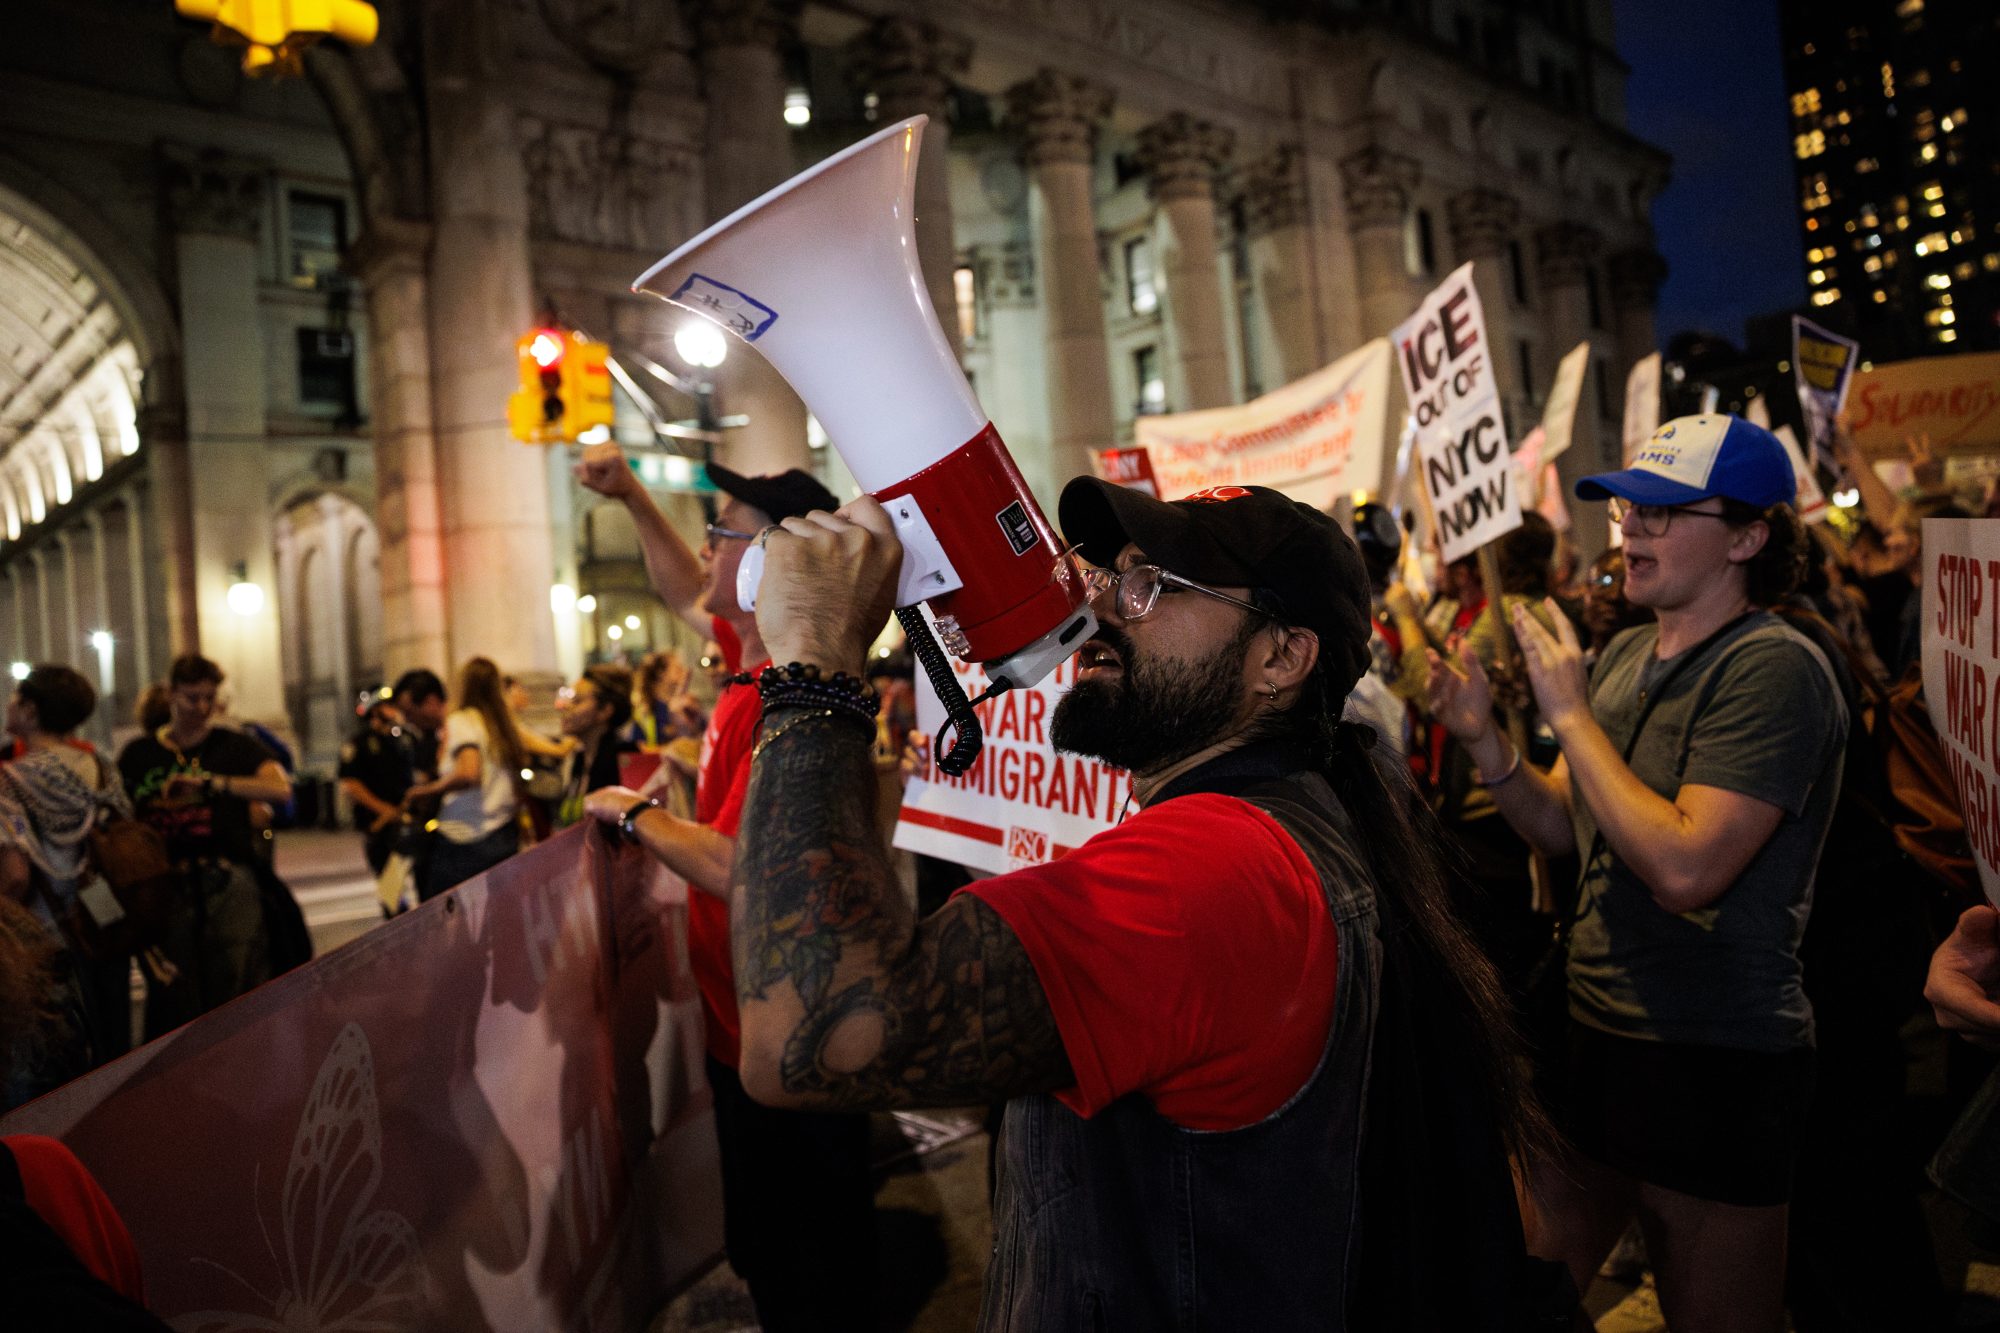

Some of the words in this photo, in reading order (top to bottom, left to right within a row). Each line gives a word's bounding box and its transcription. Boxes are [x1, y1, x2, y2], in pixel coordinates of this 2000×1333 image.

[1402, 287, 1478, 392] ICE
[1453, 354, 1482, 398] OF
[1428, 416, 1500, 498] NYC
[1439, 470, 1506, 544] NOW
[1938, 553, 1983, 650] STOP
[968, 683, 1046, 745] WAR
[1944, 649, 1986, 763] WAR
